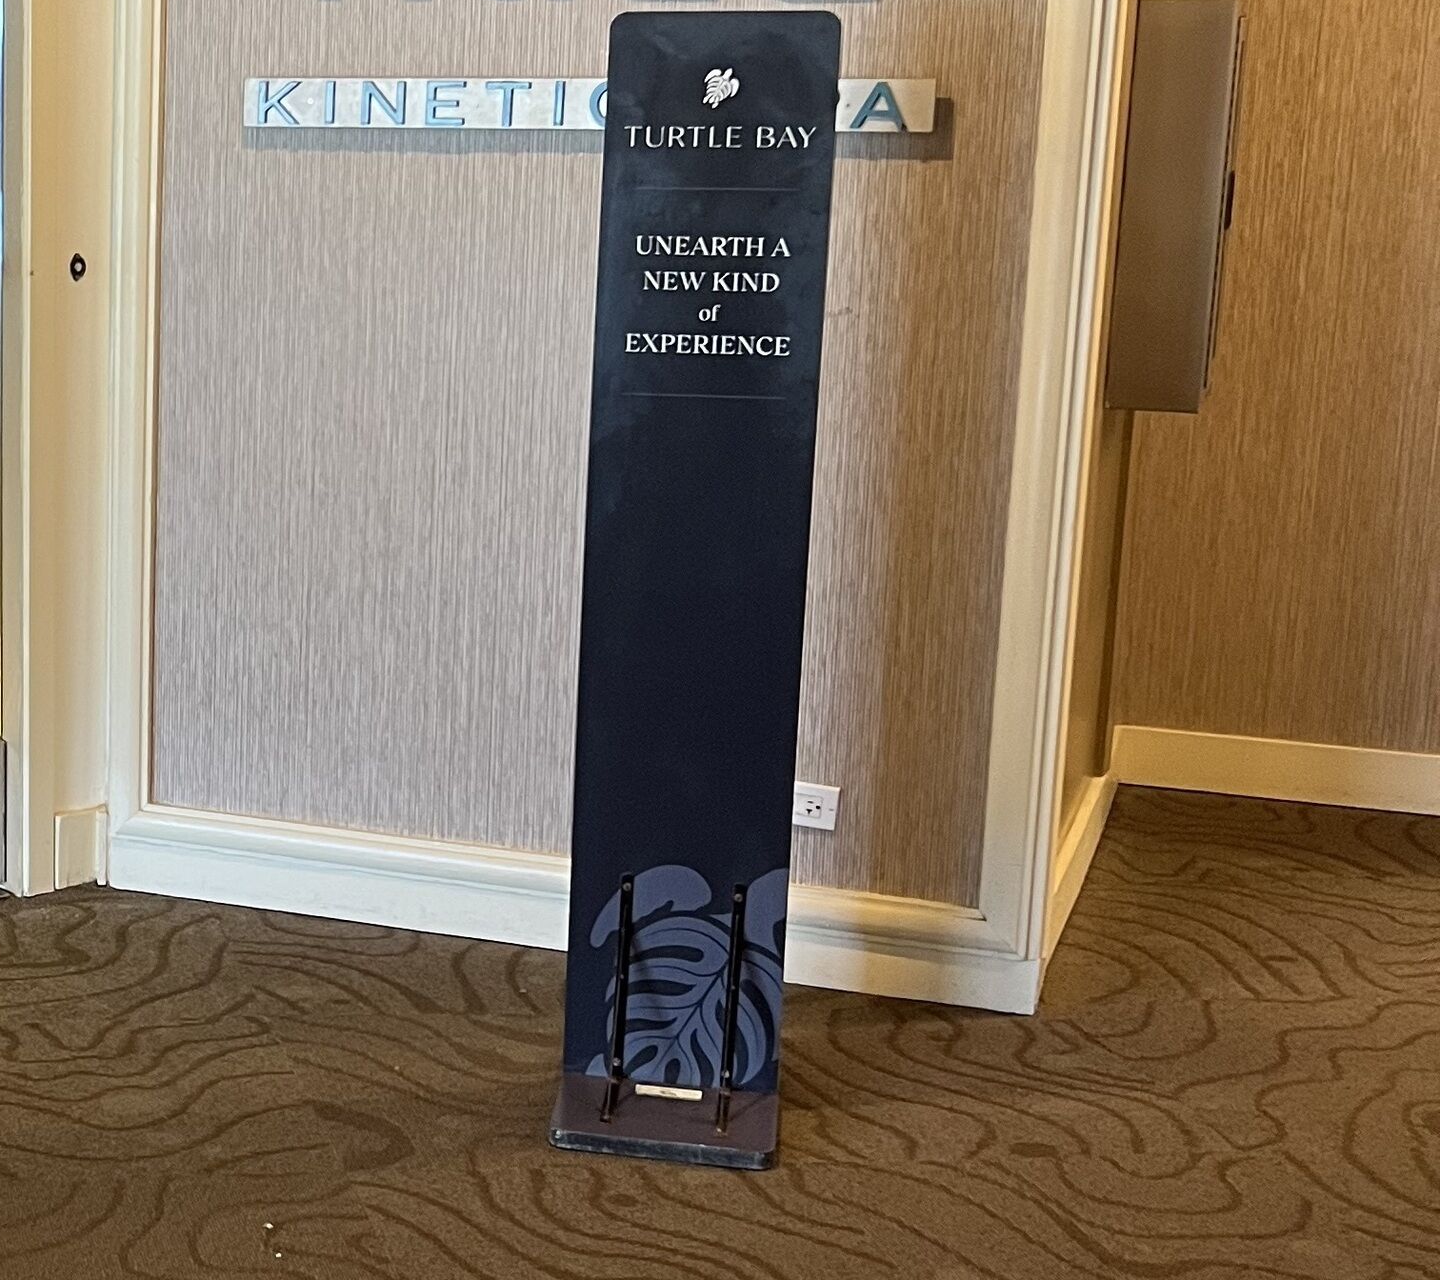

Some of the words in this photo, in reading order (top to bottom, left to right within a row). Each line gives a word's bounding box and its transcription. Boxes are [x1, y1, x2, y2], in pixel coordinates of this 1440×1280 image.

[624, 125, 743, 149] TURTLE
[756, 126, 817, 149] BAY
[636, 235, 765, 258] UNEARTH
[770, 237, 791, 258] A
[643, 271, 706, 291] NEW
[712, 272, 781, 293] KIND
[698, 304, 721, 322] of
[624, 333, 791, 356] EXPERIENCE
